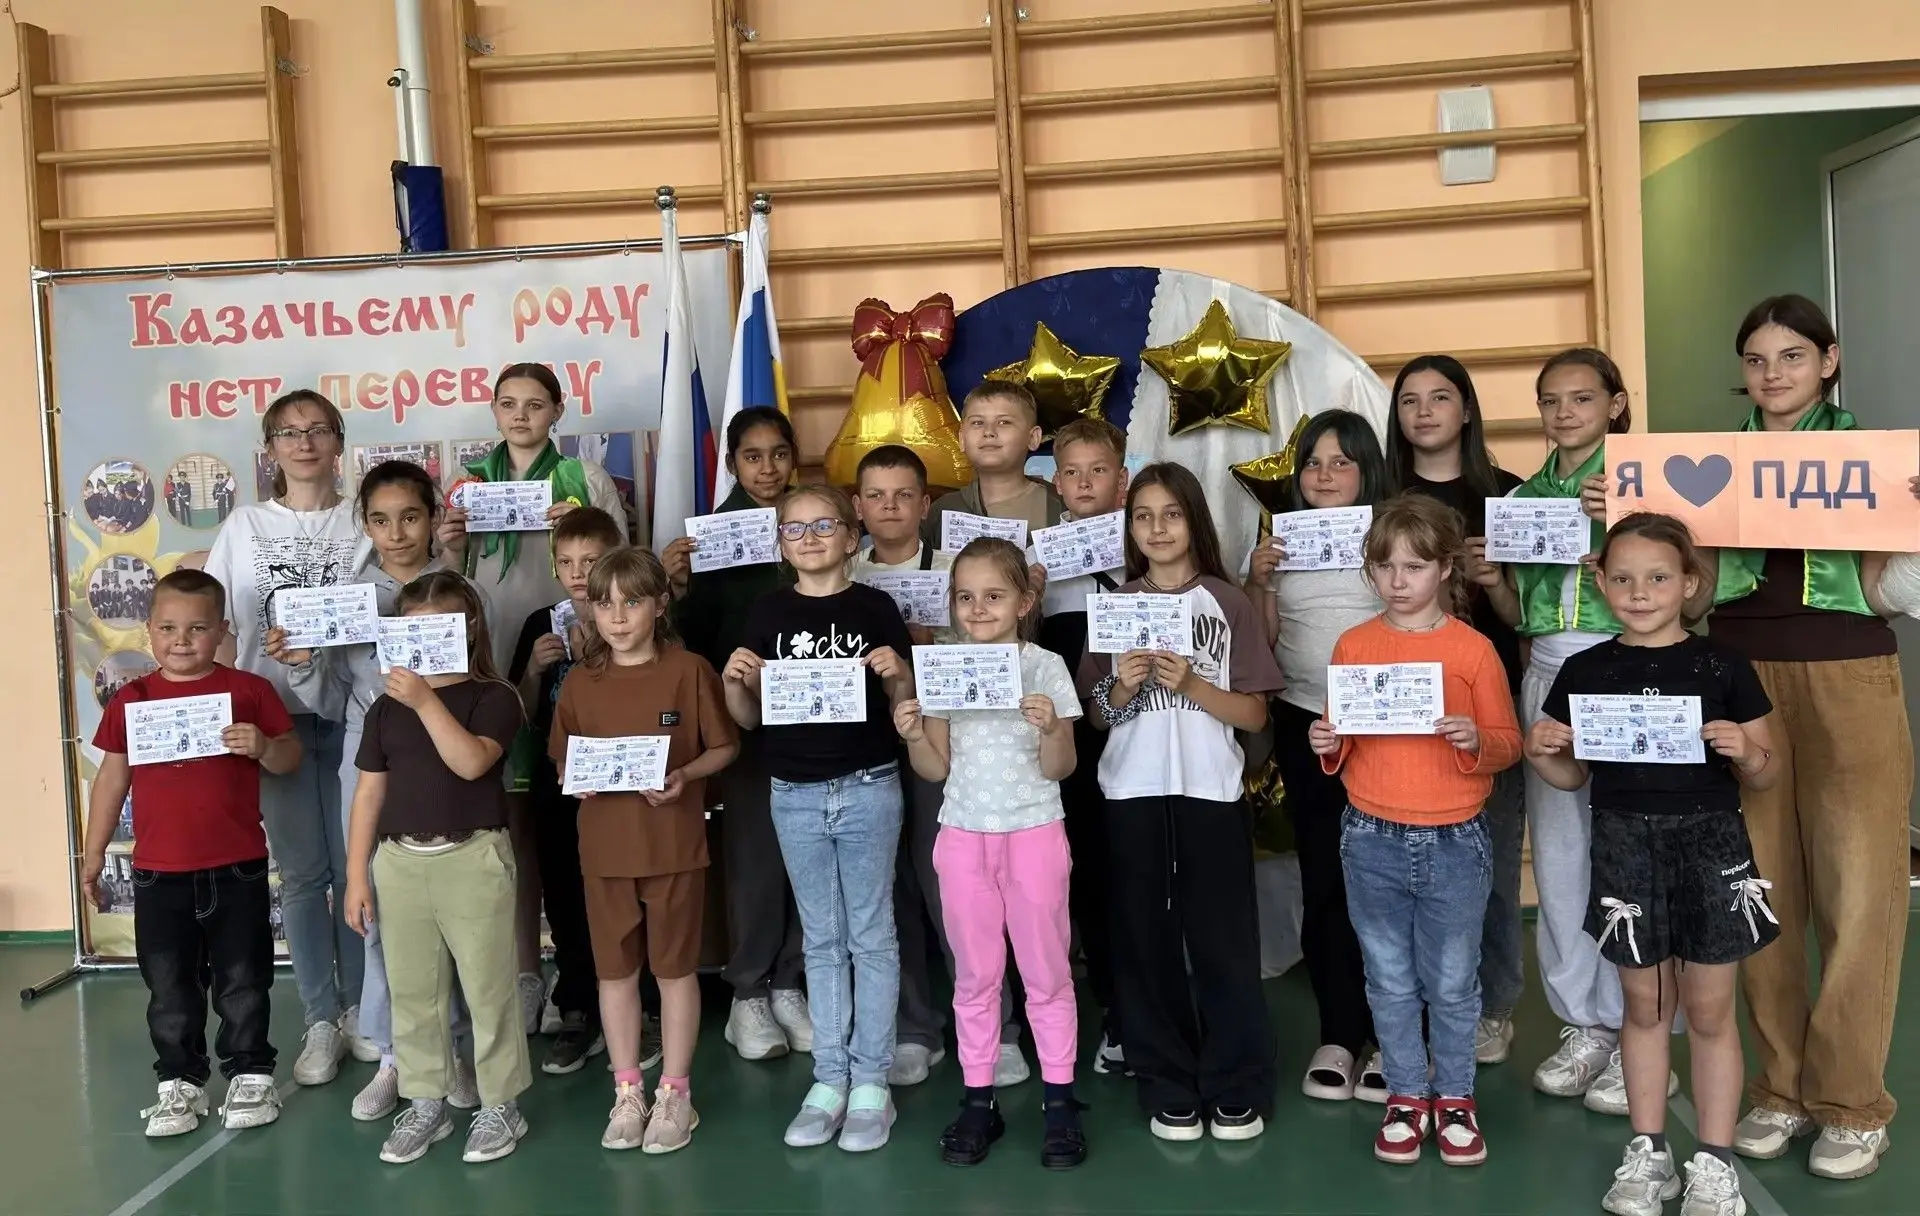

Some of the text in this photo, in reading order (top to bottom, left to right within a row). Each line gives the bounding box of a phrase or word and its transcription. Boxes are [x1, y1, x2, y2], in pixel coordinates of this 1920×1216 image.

[128, 282, 650, 348] Казачьему роду
[168, 359, 602, 425] нет переву
[1615, 459, 1877, 510] Я ПДД
